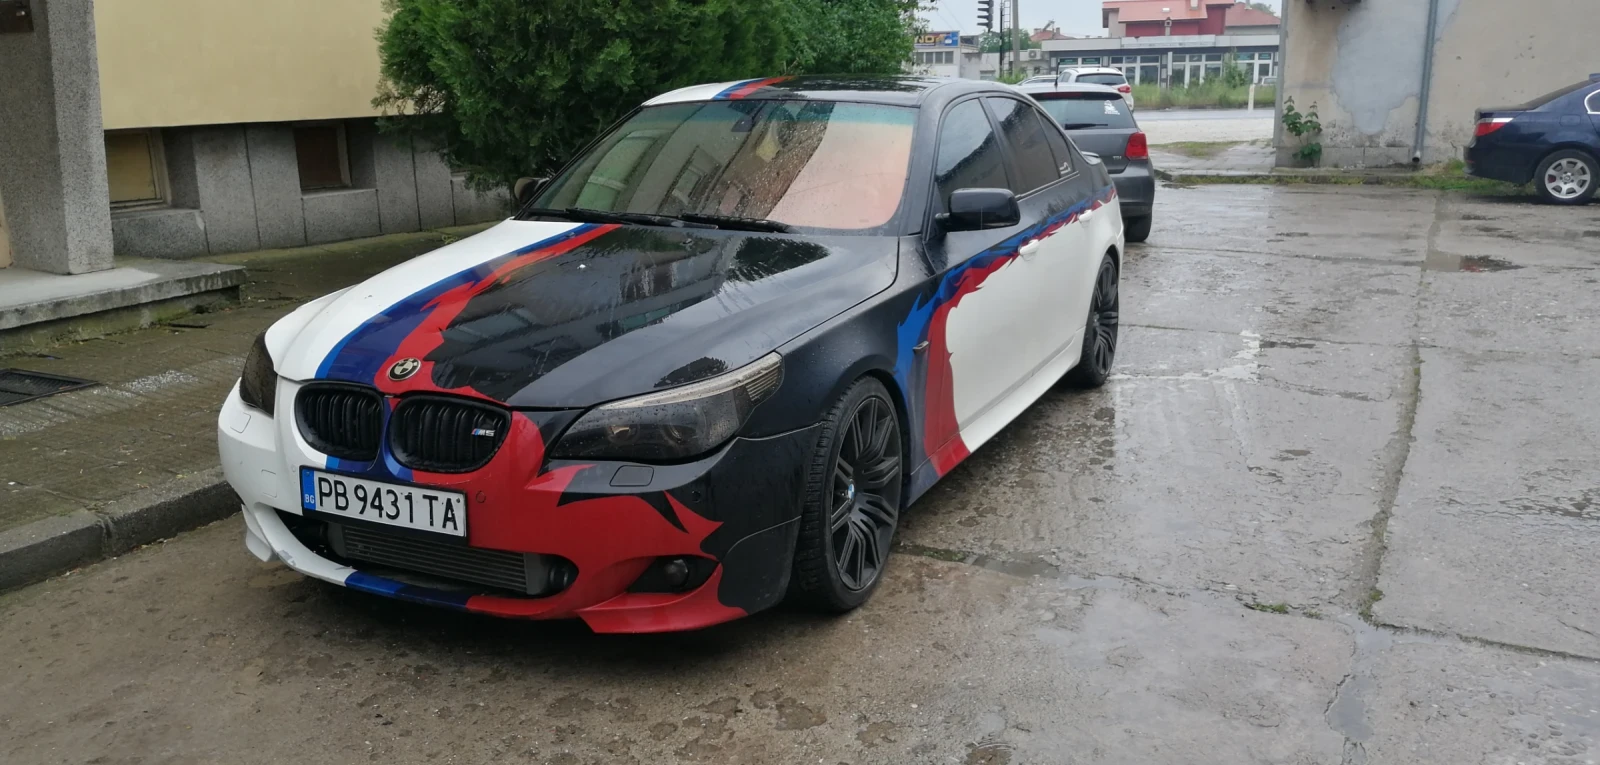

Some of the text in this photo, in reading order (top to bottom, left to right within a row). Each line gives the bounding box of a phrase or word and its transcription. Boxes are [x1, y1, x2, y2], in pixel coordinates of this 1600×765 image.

[304, 493, 315, 504] BG
[318, 477, 458, 531] PB 9431 TA
